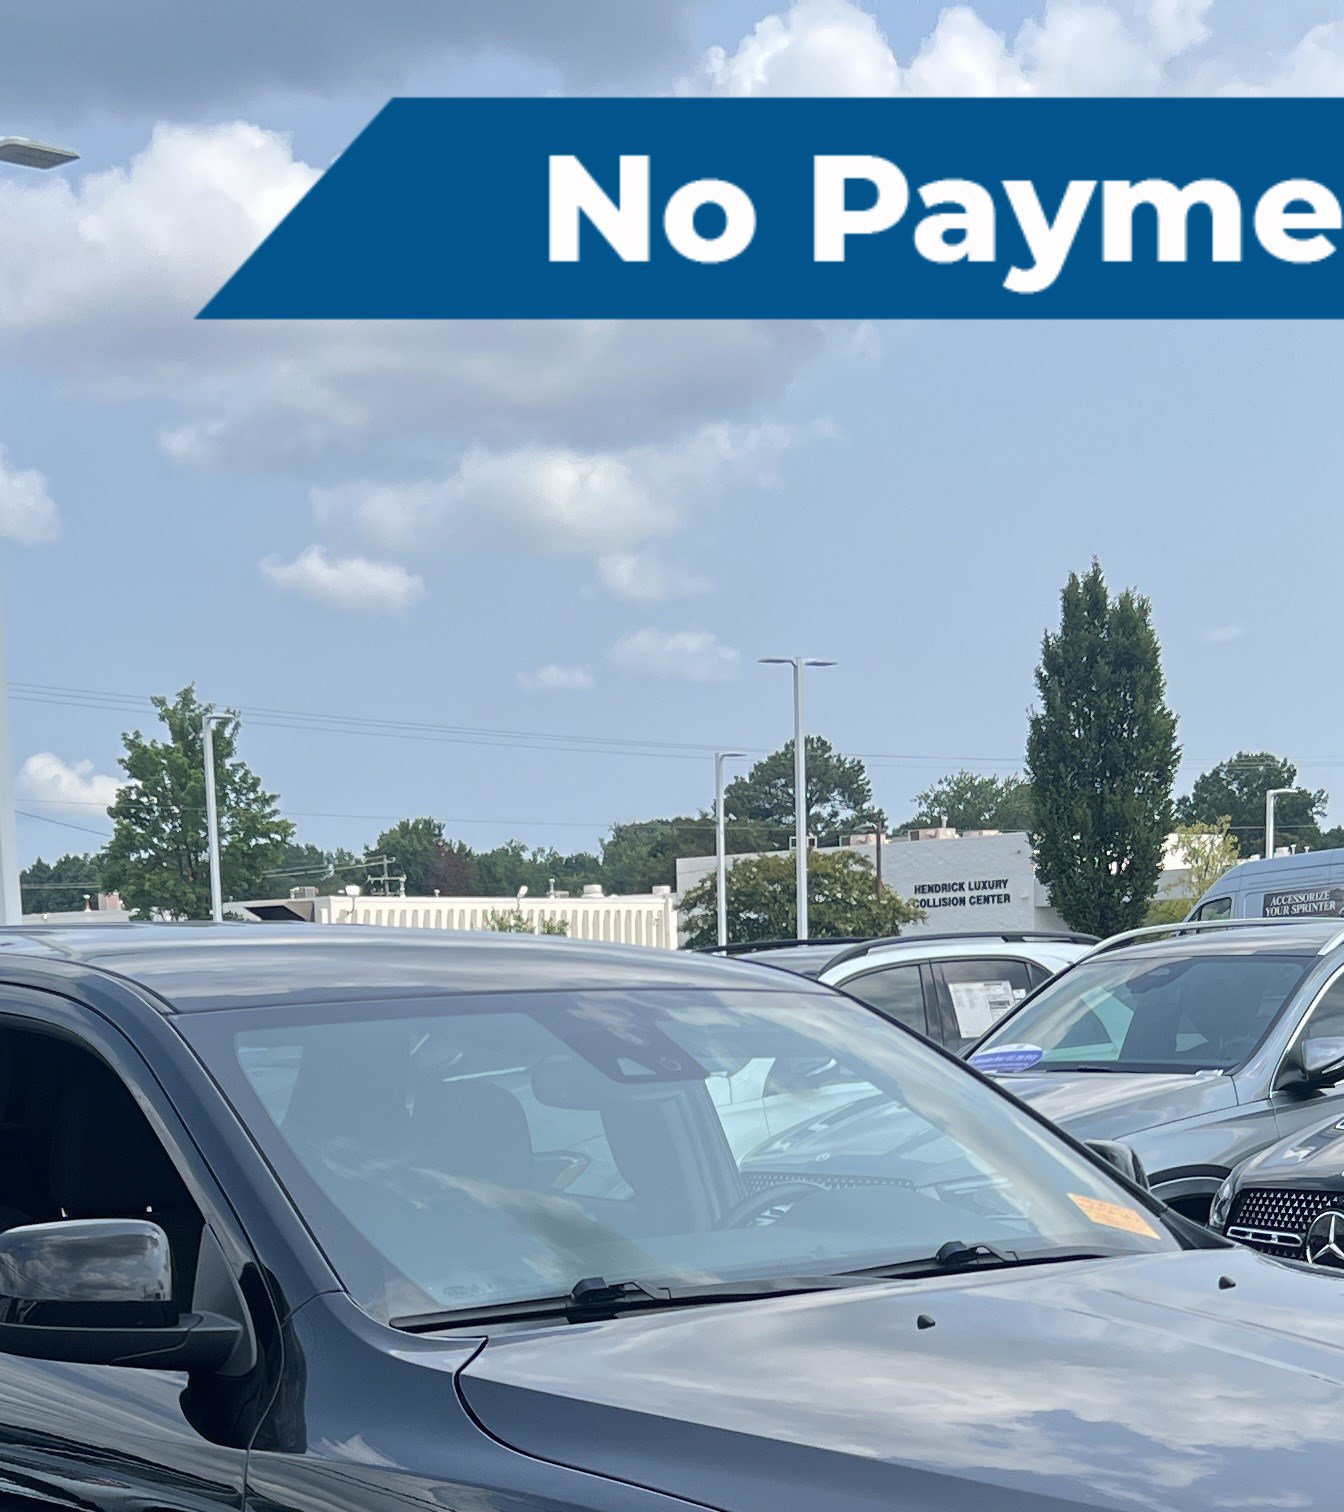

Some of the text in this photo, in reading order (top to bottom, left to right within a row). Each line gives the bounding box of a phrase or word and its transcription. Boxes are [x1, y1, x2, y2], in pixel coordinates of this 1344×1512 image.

[914, 879, 1009, 894] HENDRICK LUXURY
[914, 894, 1011, 908] COLLISION CENTER
[1270, 890, 1331, 906] ACCESSORIZE
[1265, 901, 1336, 917] YOUR SPRINTER
